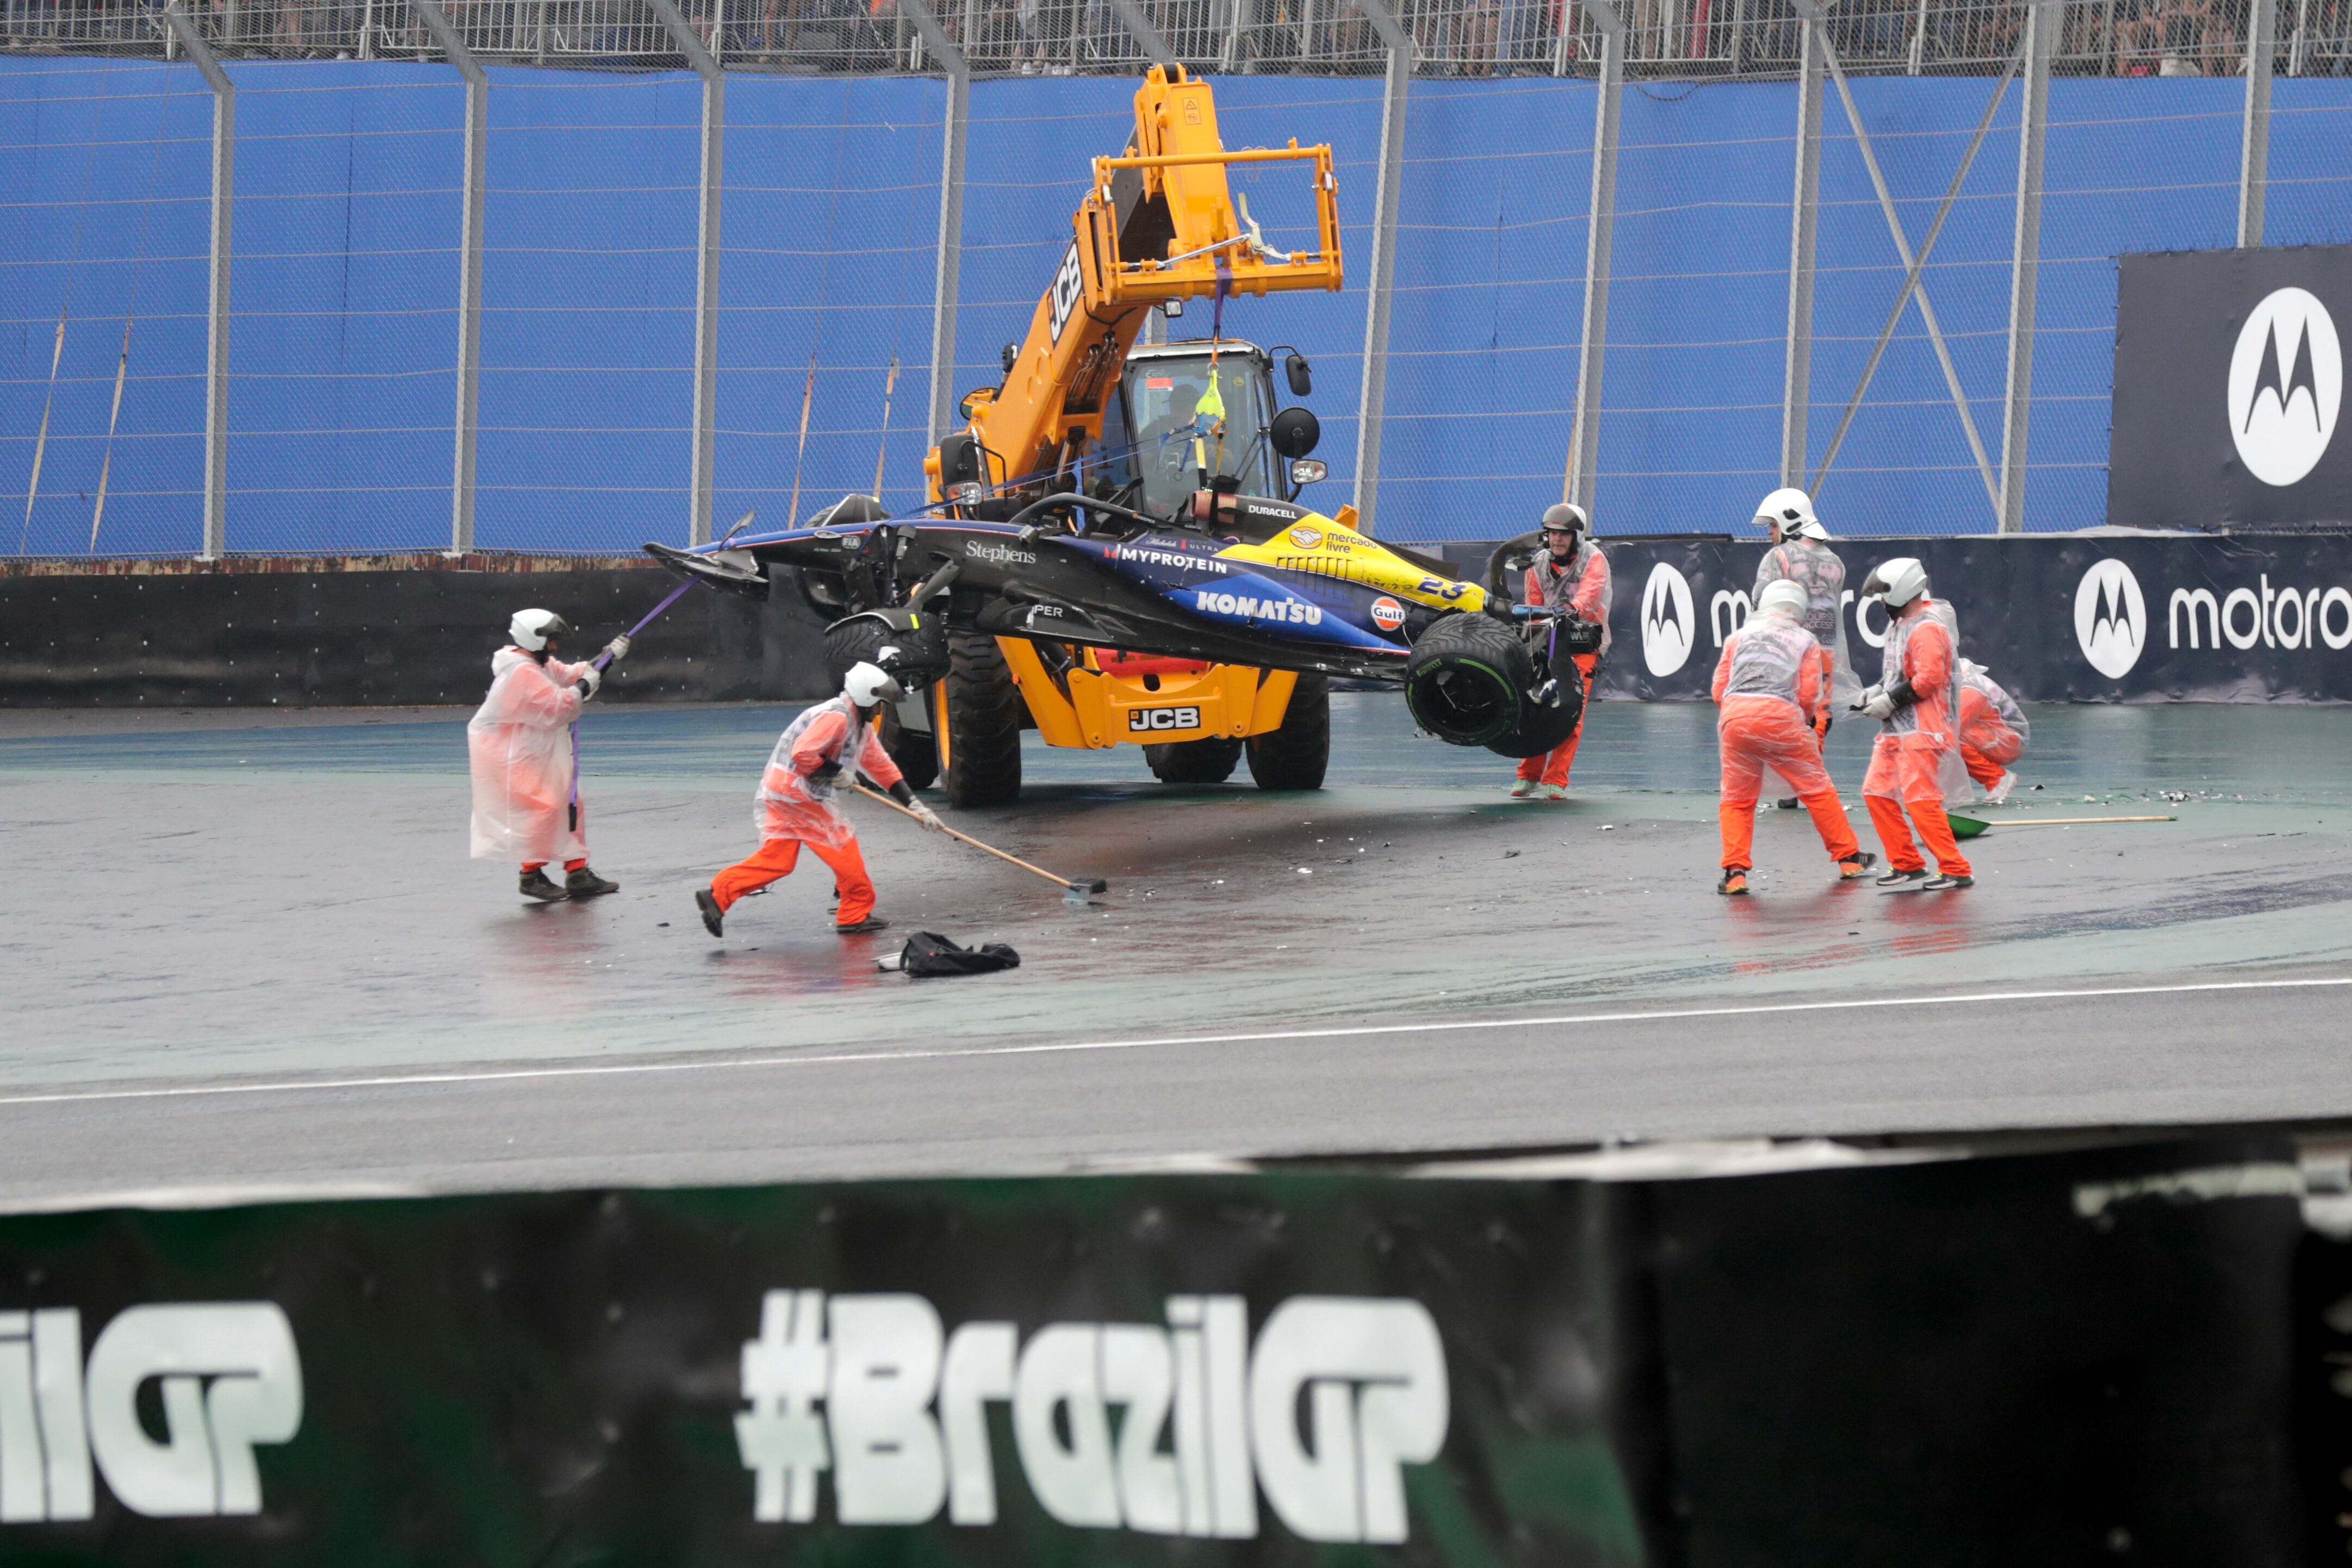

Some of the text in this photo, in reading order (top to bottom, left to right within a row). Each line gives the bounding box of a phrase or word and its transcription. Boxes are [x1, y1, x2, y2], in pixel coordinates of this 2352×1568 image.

[1051, 243, 1082, 341] JCB
[1248, 505, 1297, 519] DURACELL
[966, 540, 1036, 563] Stephens
[1326, 540, 1351, 553] livre
[1327, 532, 1377, 549] mercado
[1122, 548, 1227, 574] MYPROTEIN
[1417, 577, 1466, 600] 23
[1196, 591, 1321, 625] KOMATSU
[1374, 607, 1404, 620] Gulf
[1804, 612, 1834, 621] OURSE
[1131, 707, 1199, 730] JCB
[734, 1289, 1450, 1544] #BrazilGP
